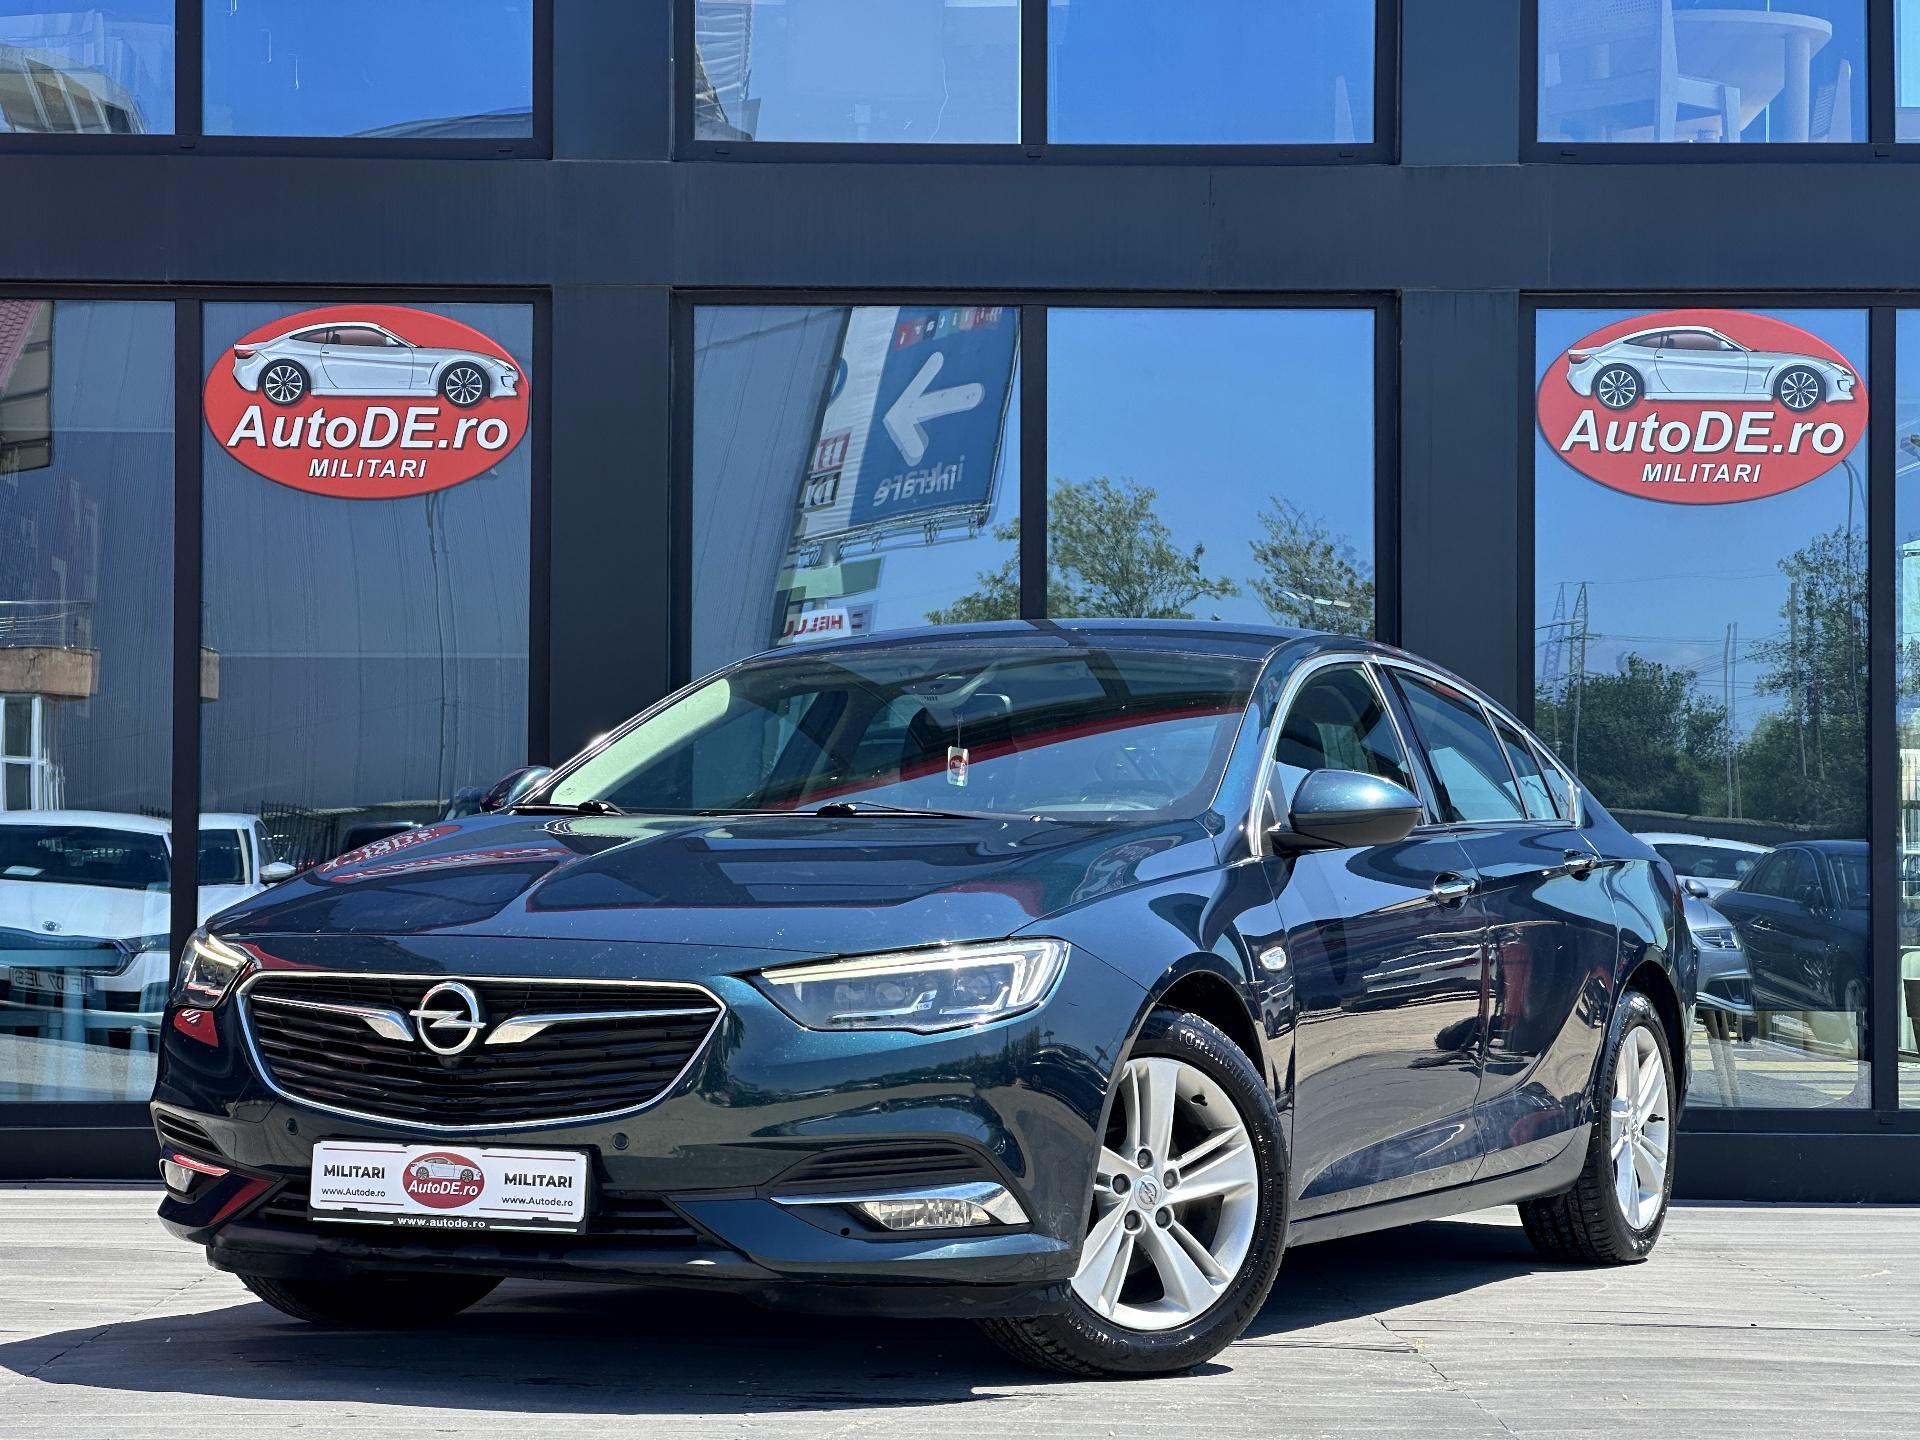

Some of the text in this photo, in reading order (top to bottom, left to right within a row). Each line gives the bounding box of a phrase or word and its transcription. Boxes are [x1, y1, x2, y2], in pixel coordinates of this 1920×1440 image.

[226, 404, 509, 450] AutoDE.ro
[1560, 409, 1846, 455] AutoDE.ro
[308, 457, 427, 479] MILITARI
[1641, 463, 1762, 484] MILITARI
[323, 1163, 386, 1180] MILITARI
[504, 1172, 574, 1189] MILITARI
[321, 1187, 386, 1198] www.Autode.ro
[407, 1179, 480, 1198] AutoDE.ro
[501, 1196, 574, 1208] www.Autode.ro
[397, 1216, 487, 1229] www.autode.ro
